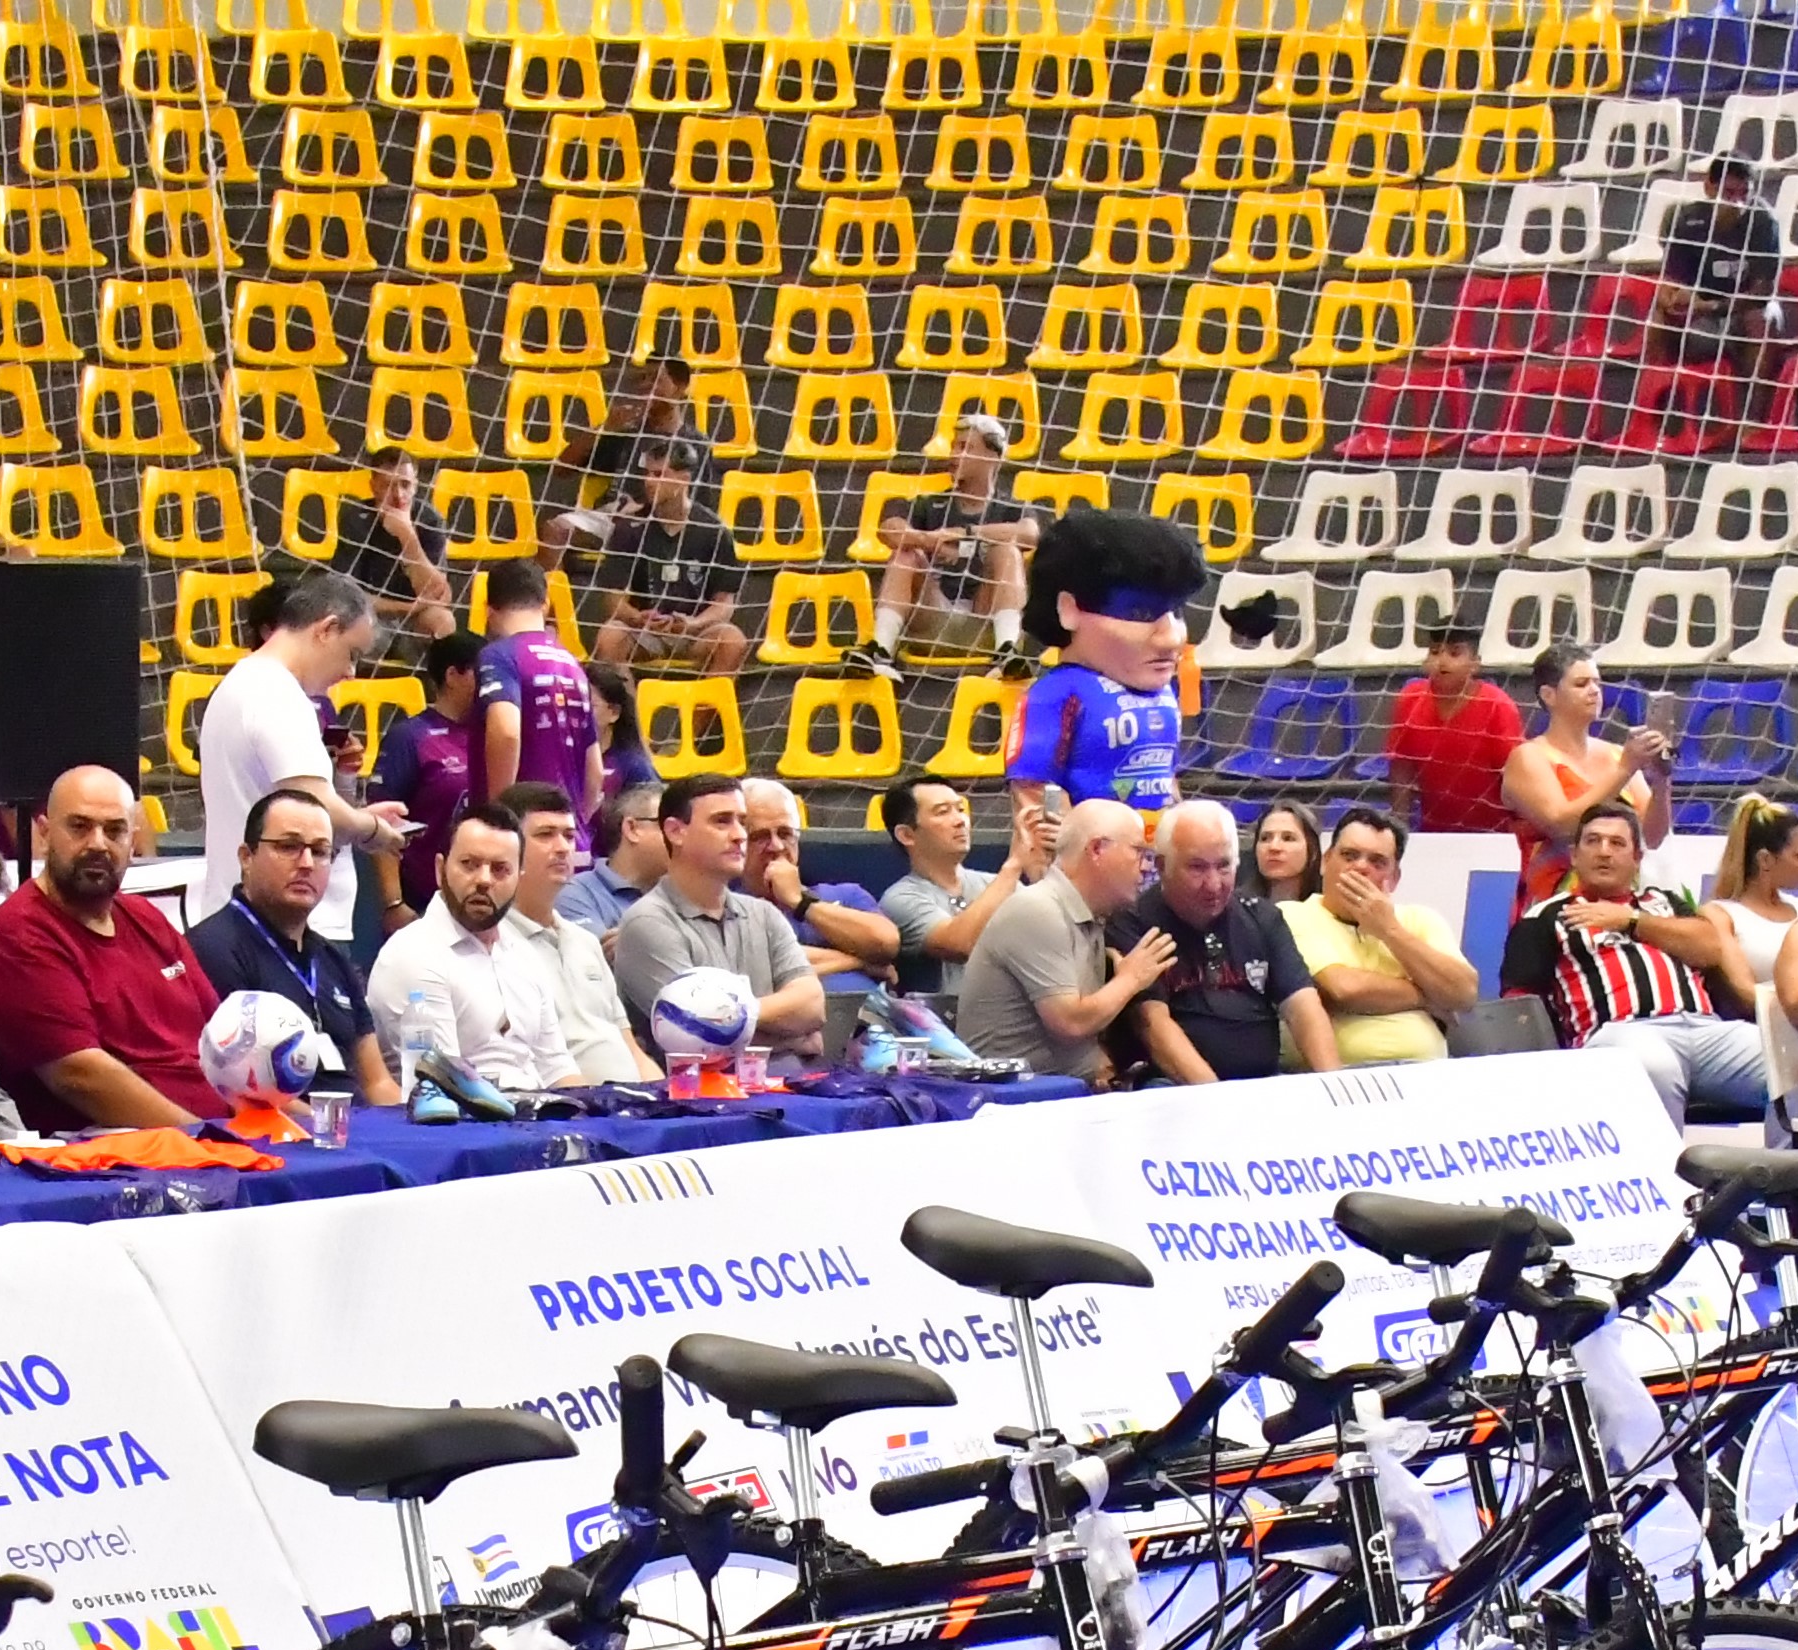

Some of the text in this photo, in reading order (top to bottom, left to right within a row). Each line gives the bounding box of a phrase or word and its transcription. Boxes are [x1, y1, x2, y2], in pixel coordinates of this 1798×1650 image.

[1103, 711, 1139, 750] 10
[1140, 1119, 1621, 1203] GAZIN, OBRIGADO PELA PARCERIA NO
[1145, 1217, 1325, 1263] PROGRAMA
[1560, 1184, 1601, 1222] DE
[1602, 1176, 1672, 1220] NOTA
[528, 1245, 871, 1332] PROJETO SOCIAL
[917, 1319, 970, 1367] do
[964, 1298, 1102, 1362] Esorte"
[3, 1430, 170, 1502] NOTA
[778, 1445, 858, 1500] vvo
[6, 1524, 137, 1588] esporte!
[71, 1581, 218, 1611] GOVERNO FEDERAL
[473, 1573, 544, 1607] Umuara
